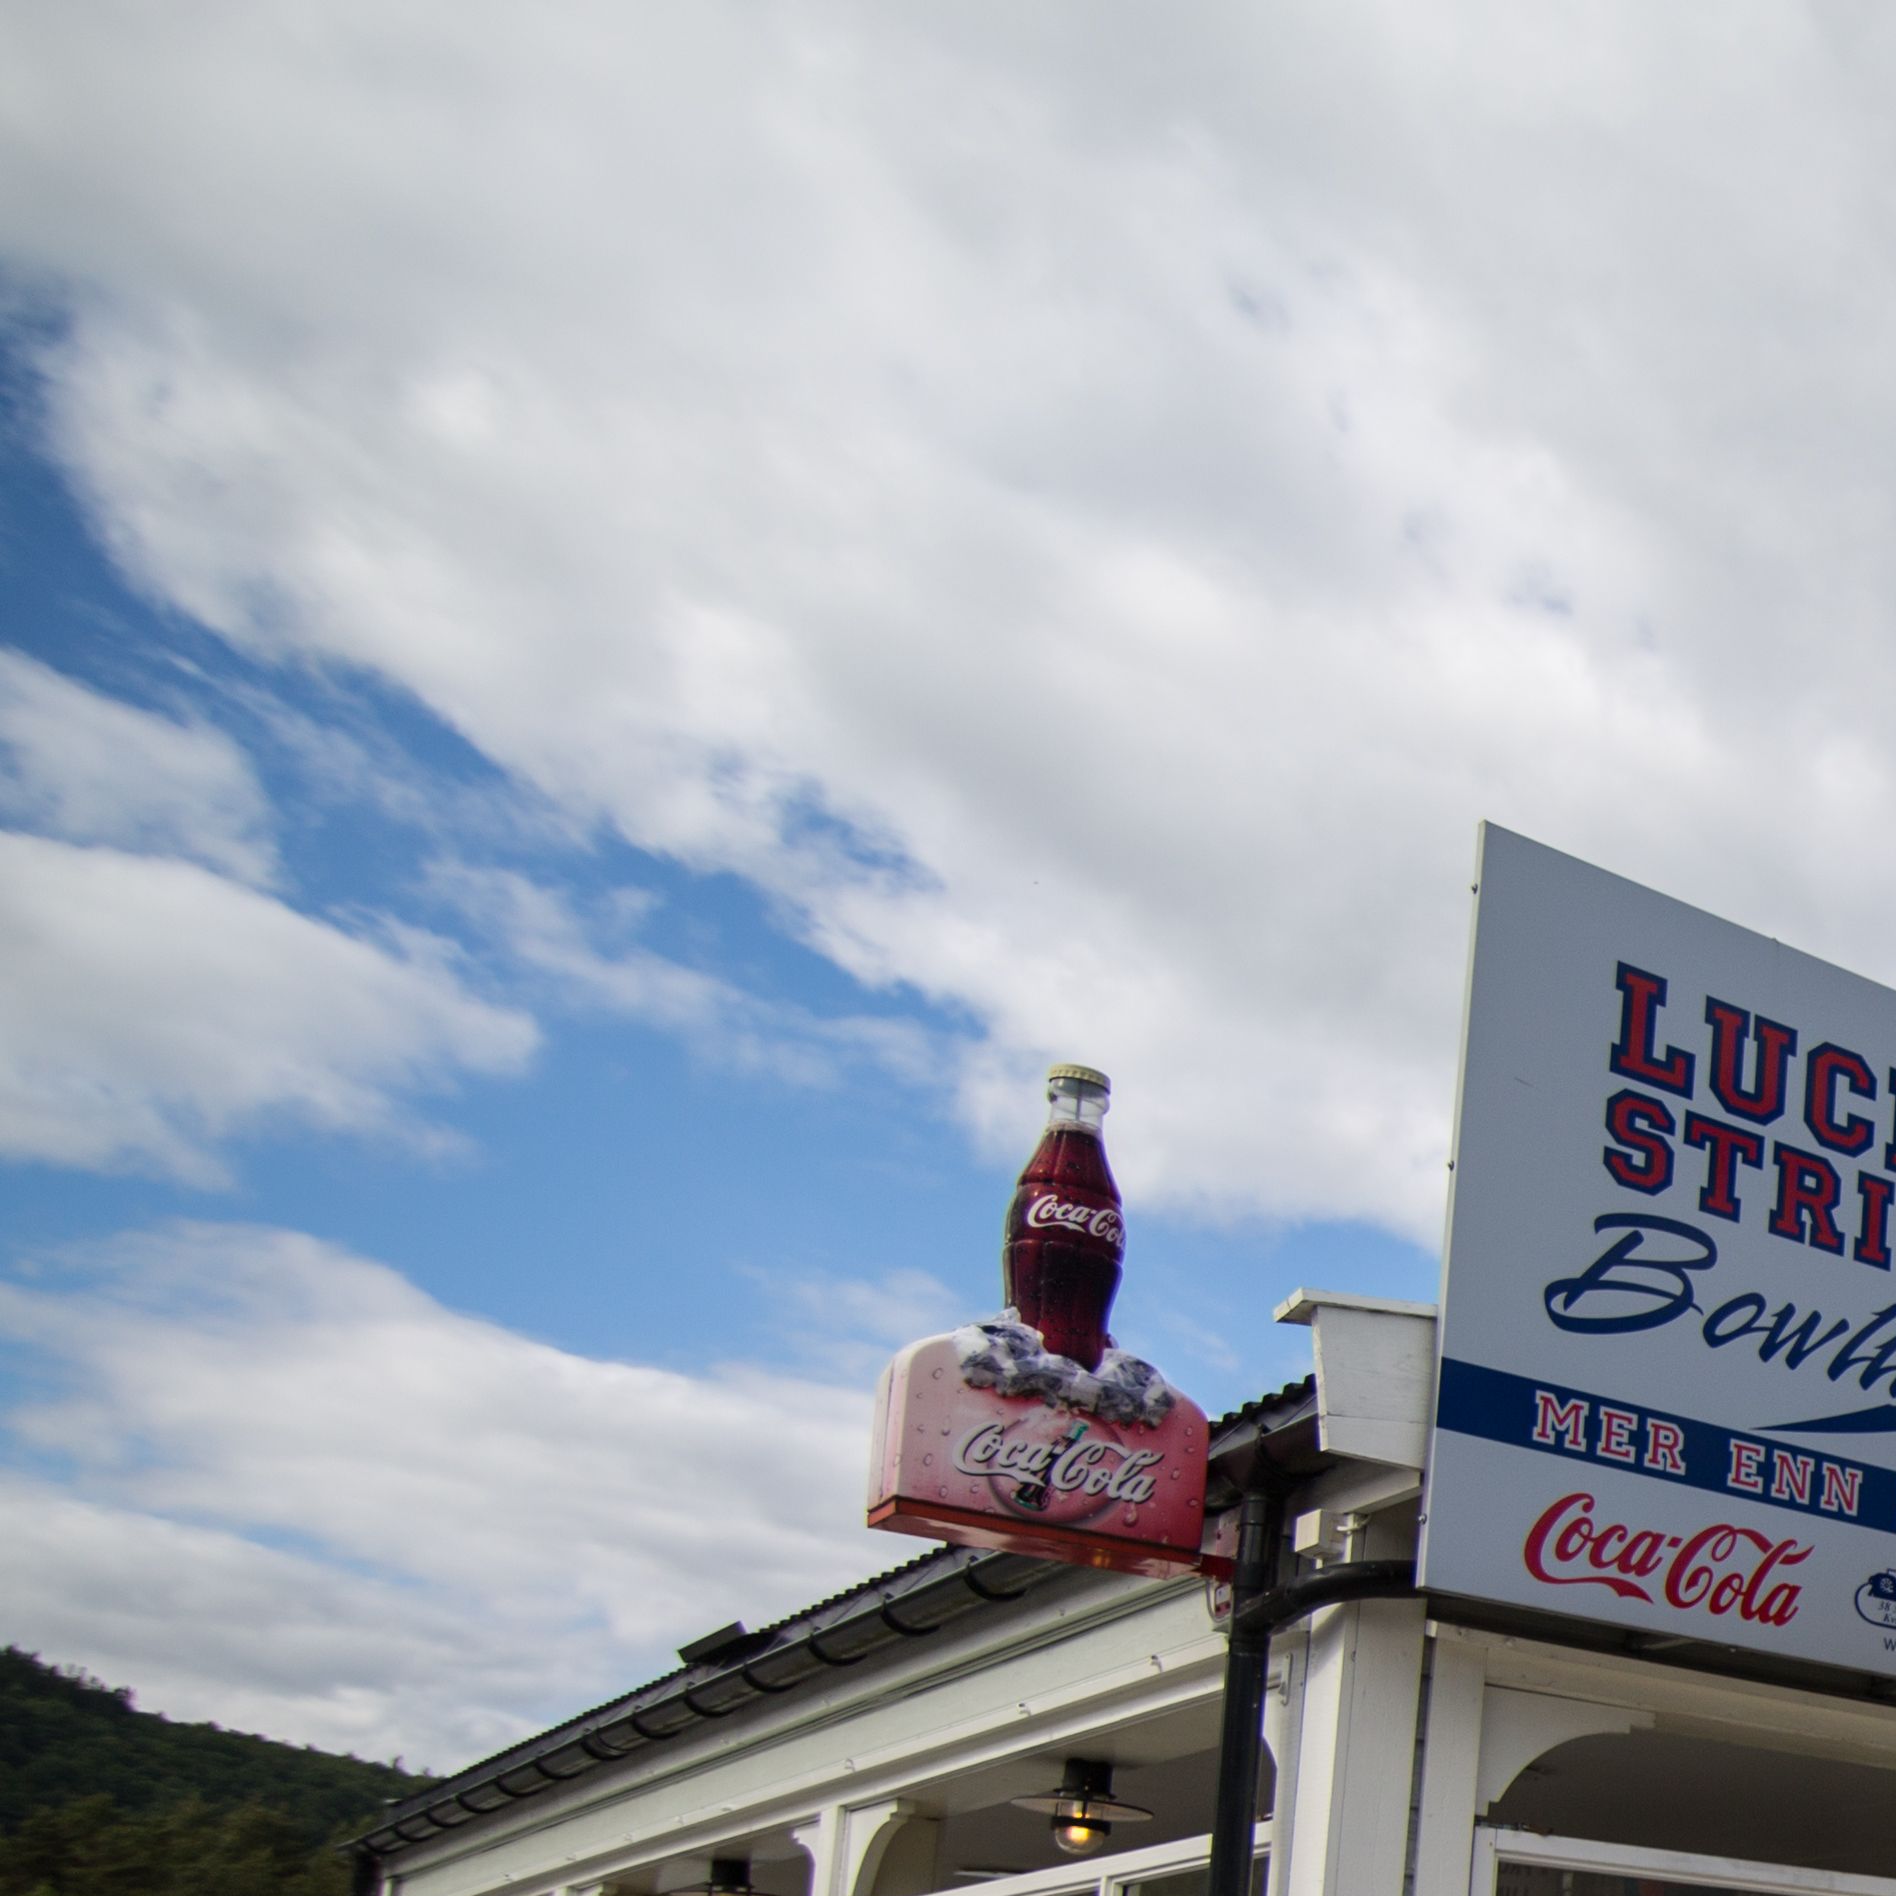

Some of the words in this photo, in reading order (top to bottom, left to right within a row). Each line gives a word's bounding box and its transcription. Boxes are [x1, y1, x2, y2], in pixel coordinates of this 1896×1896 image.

[1027, 1194, 1126, 1251] Coca-Col
[952, 1423, 1163, 1503] Coca-Cola
[1532, 1391, 1687, 1477] MER
[1728, 1440, 1862, 1517] ENN
[1524, 1493, 1814, 1627] Coca-Cola
